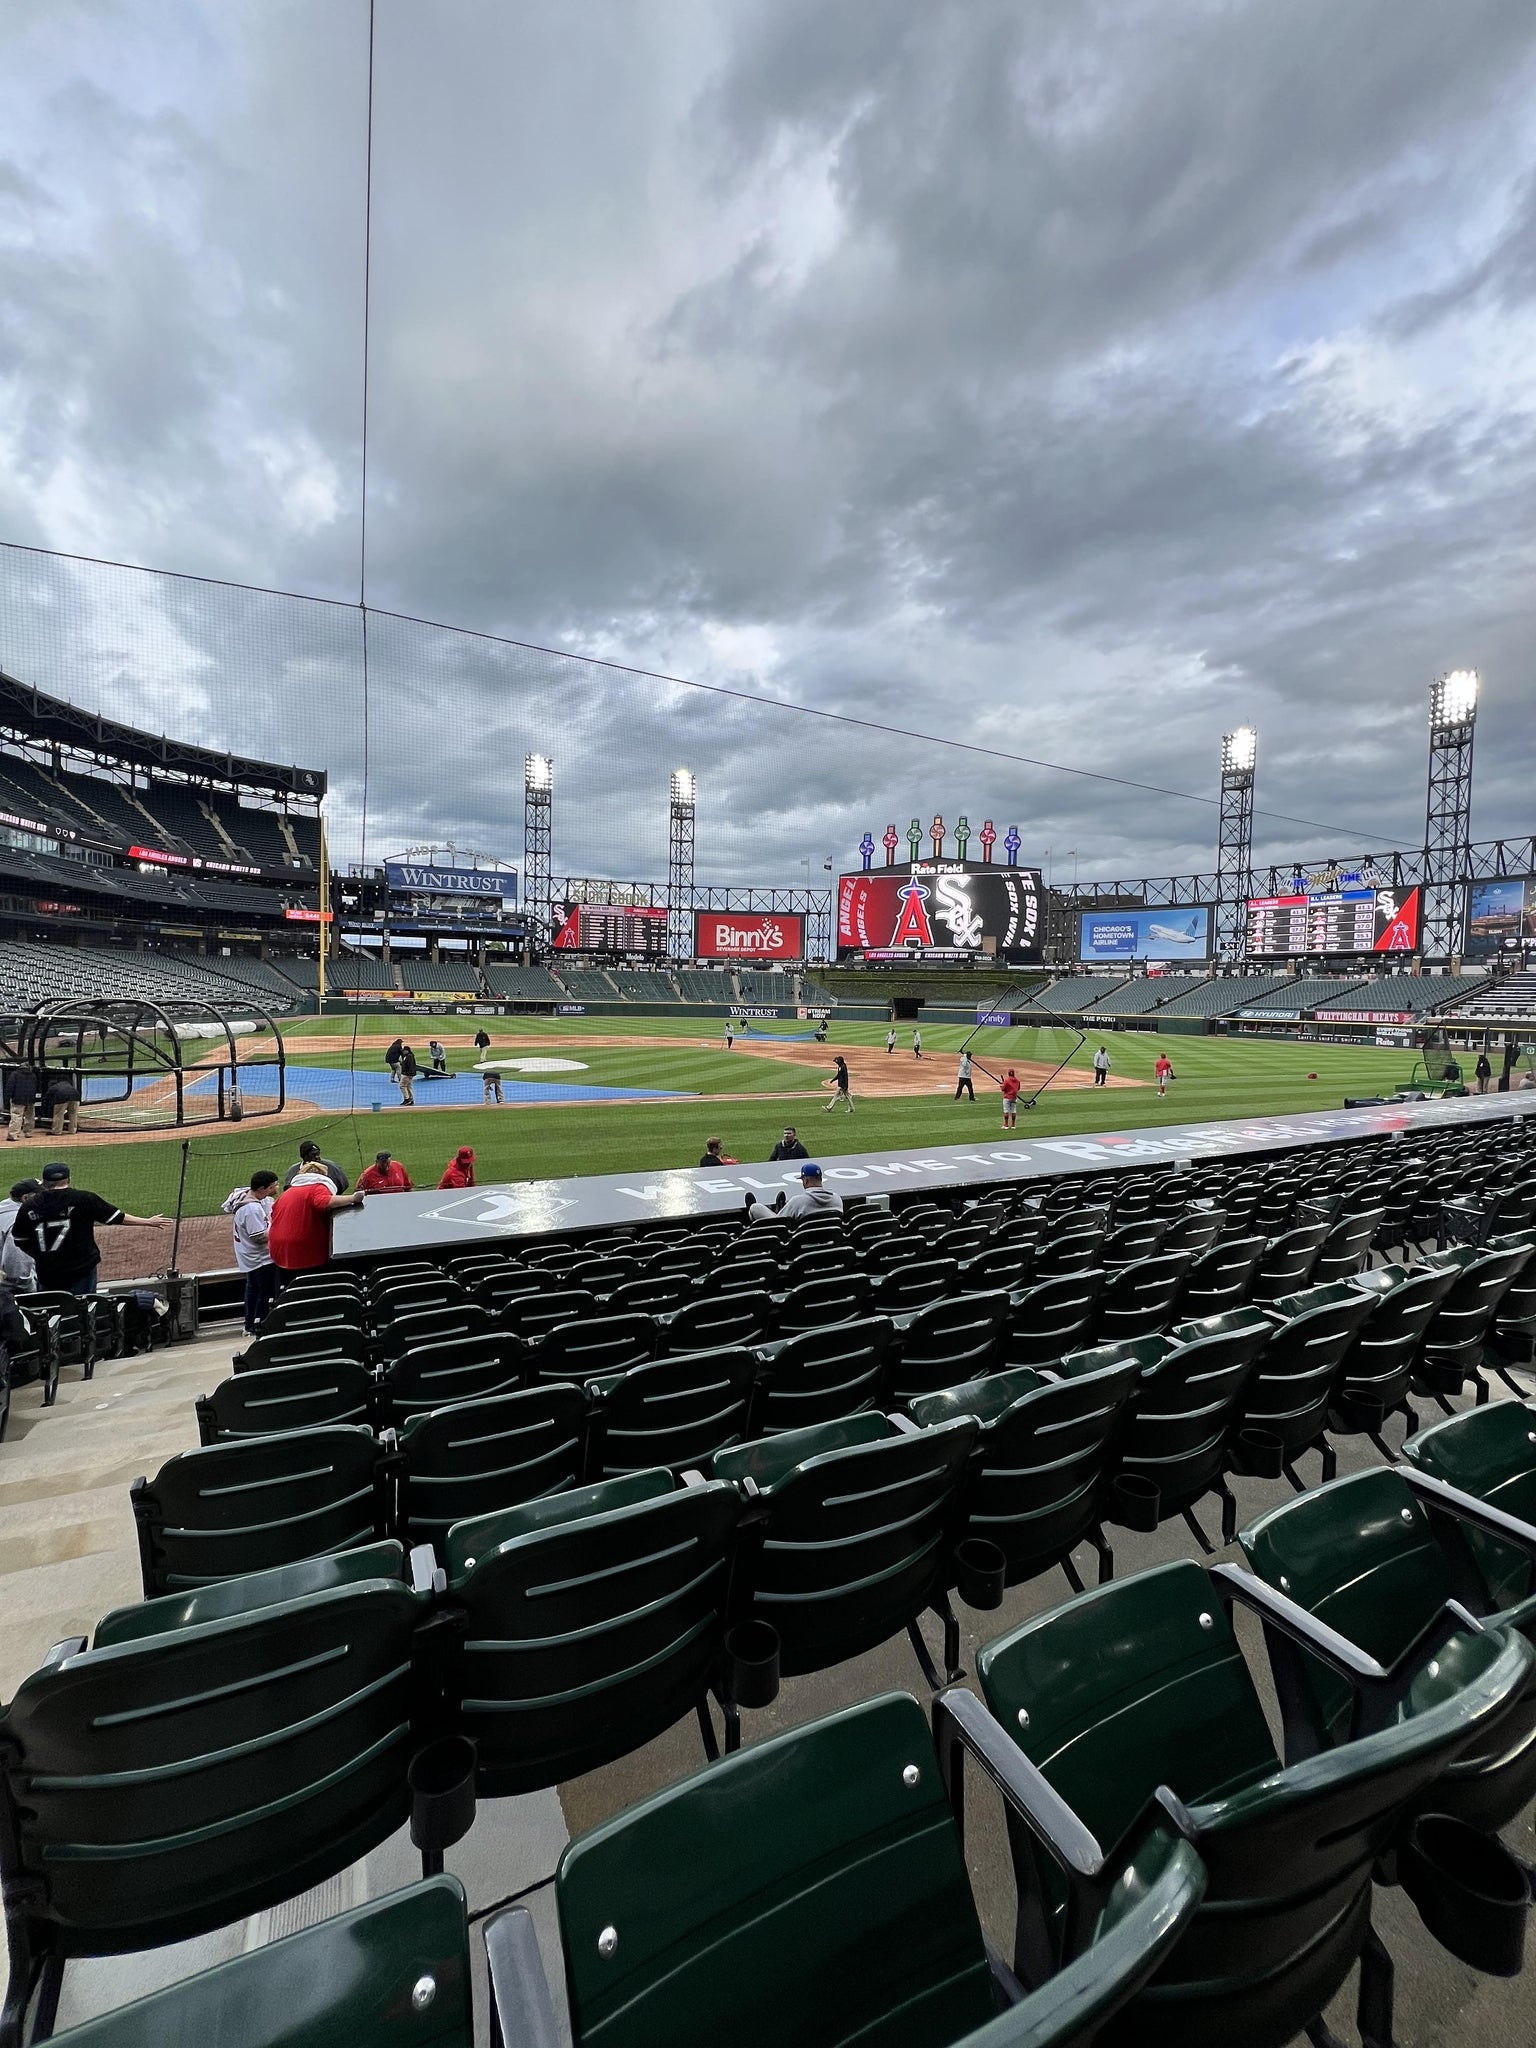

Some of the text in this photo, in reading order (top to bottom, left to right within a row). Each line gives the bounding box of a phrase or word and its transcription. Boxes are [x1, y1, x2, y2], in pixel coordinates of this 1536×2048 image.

[405, 845, 439, 857] KIDS
[911, 863, 963, 874] Rate Field
[400, 867, 504, 892] WINTRUST
[1339, 872, 1363, 883] TIME
[573, 889, 649, 906] SPORTSBOOK
[1093, 925, 1132, 933] CHICAGO'S
[1092, 938, 1119, 946] AIRLINE
[729, 1006, 779, 1018] WINTRUST
[1316, 1011, 1400, 1023] WHITTINGHAM MEATS
[1375, 1037, 1395, 1046] Rate
[1032, 1122, 1334, 1161] Rate Field
[952, 1151, 1033, 1167] TO
[35, 1219, 71, 1252] 17
